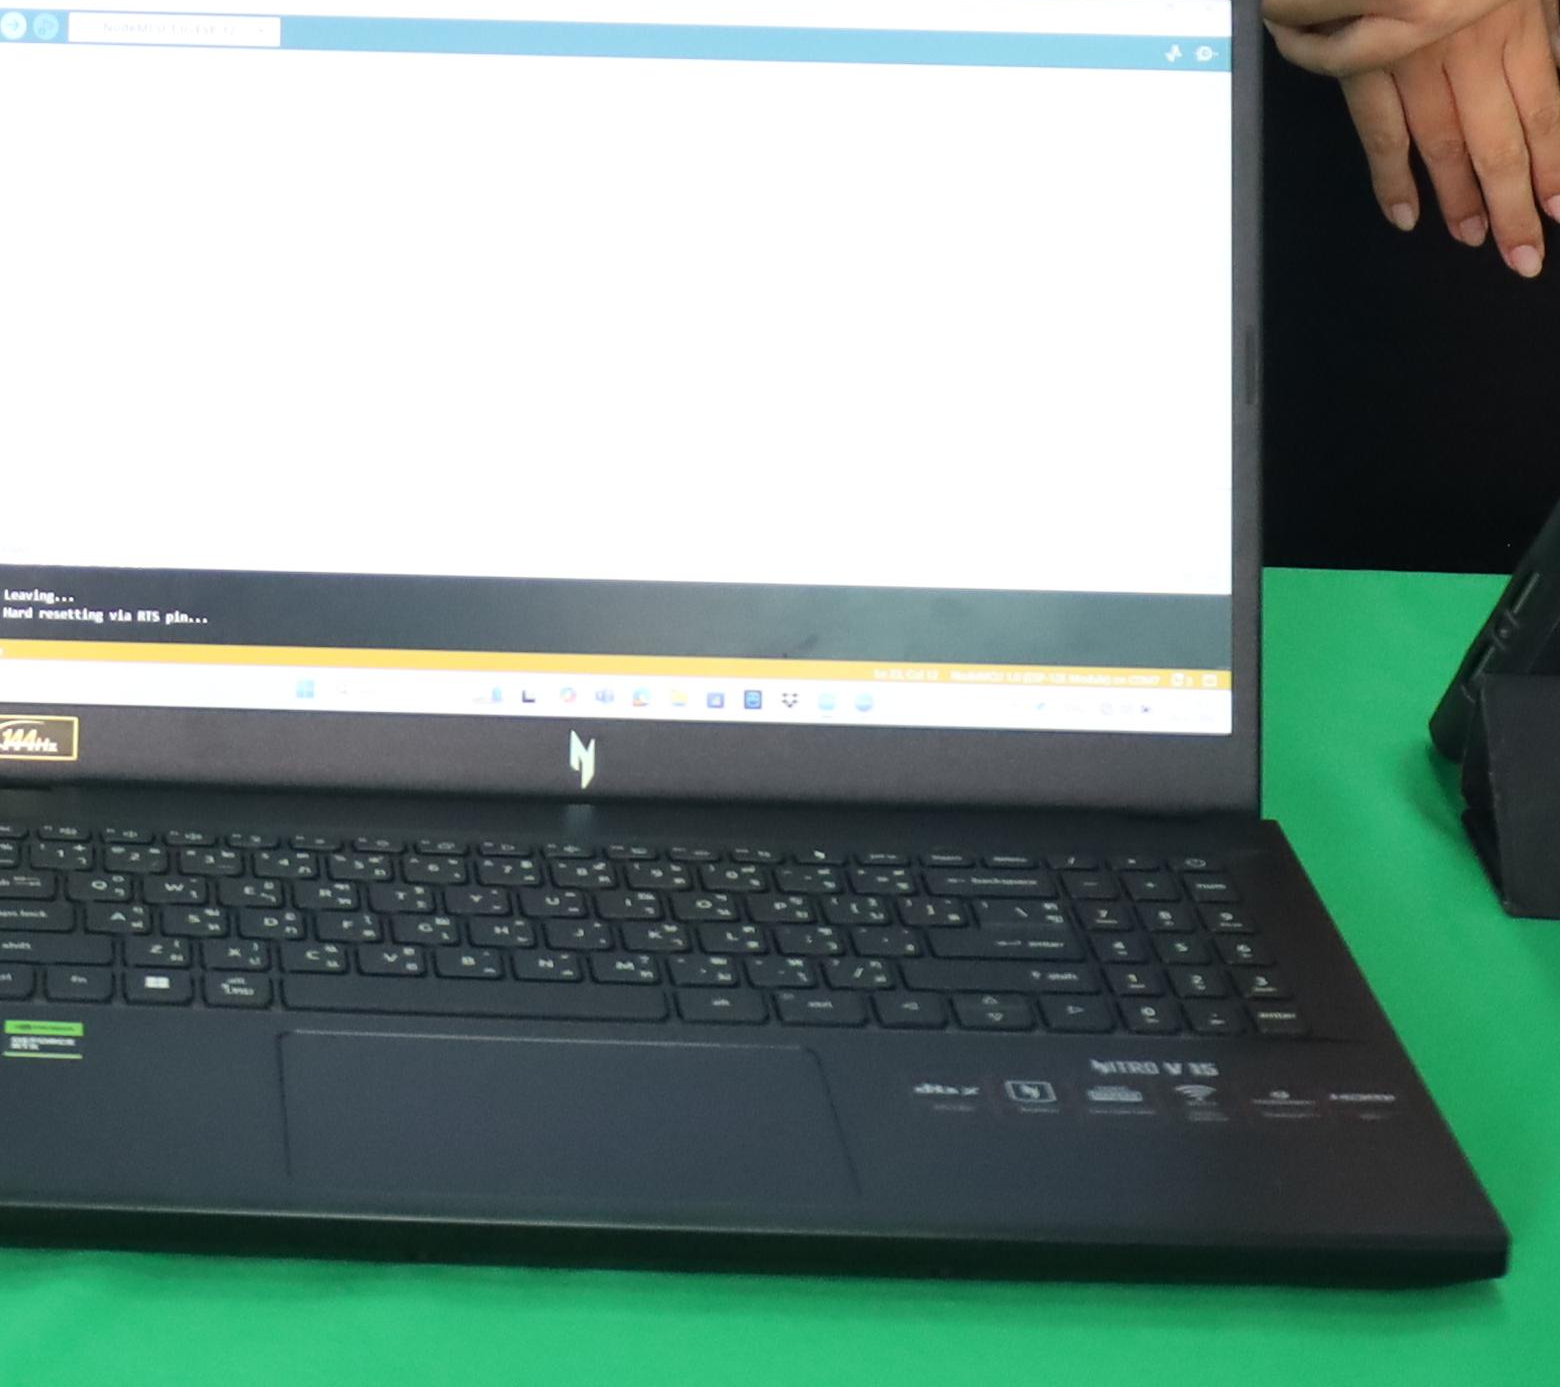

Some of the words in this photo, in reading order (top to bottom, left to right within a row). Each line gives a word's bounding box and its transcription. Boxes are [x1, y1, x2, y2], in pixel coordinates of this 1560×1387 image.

[4, 588, 74, 605] Leaving...
[3, 606, 33, 620] Hard
[39, 607, 104, 623] resetting
[109, 609, 132, 622] via
